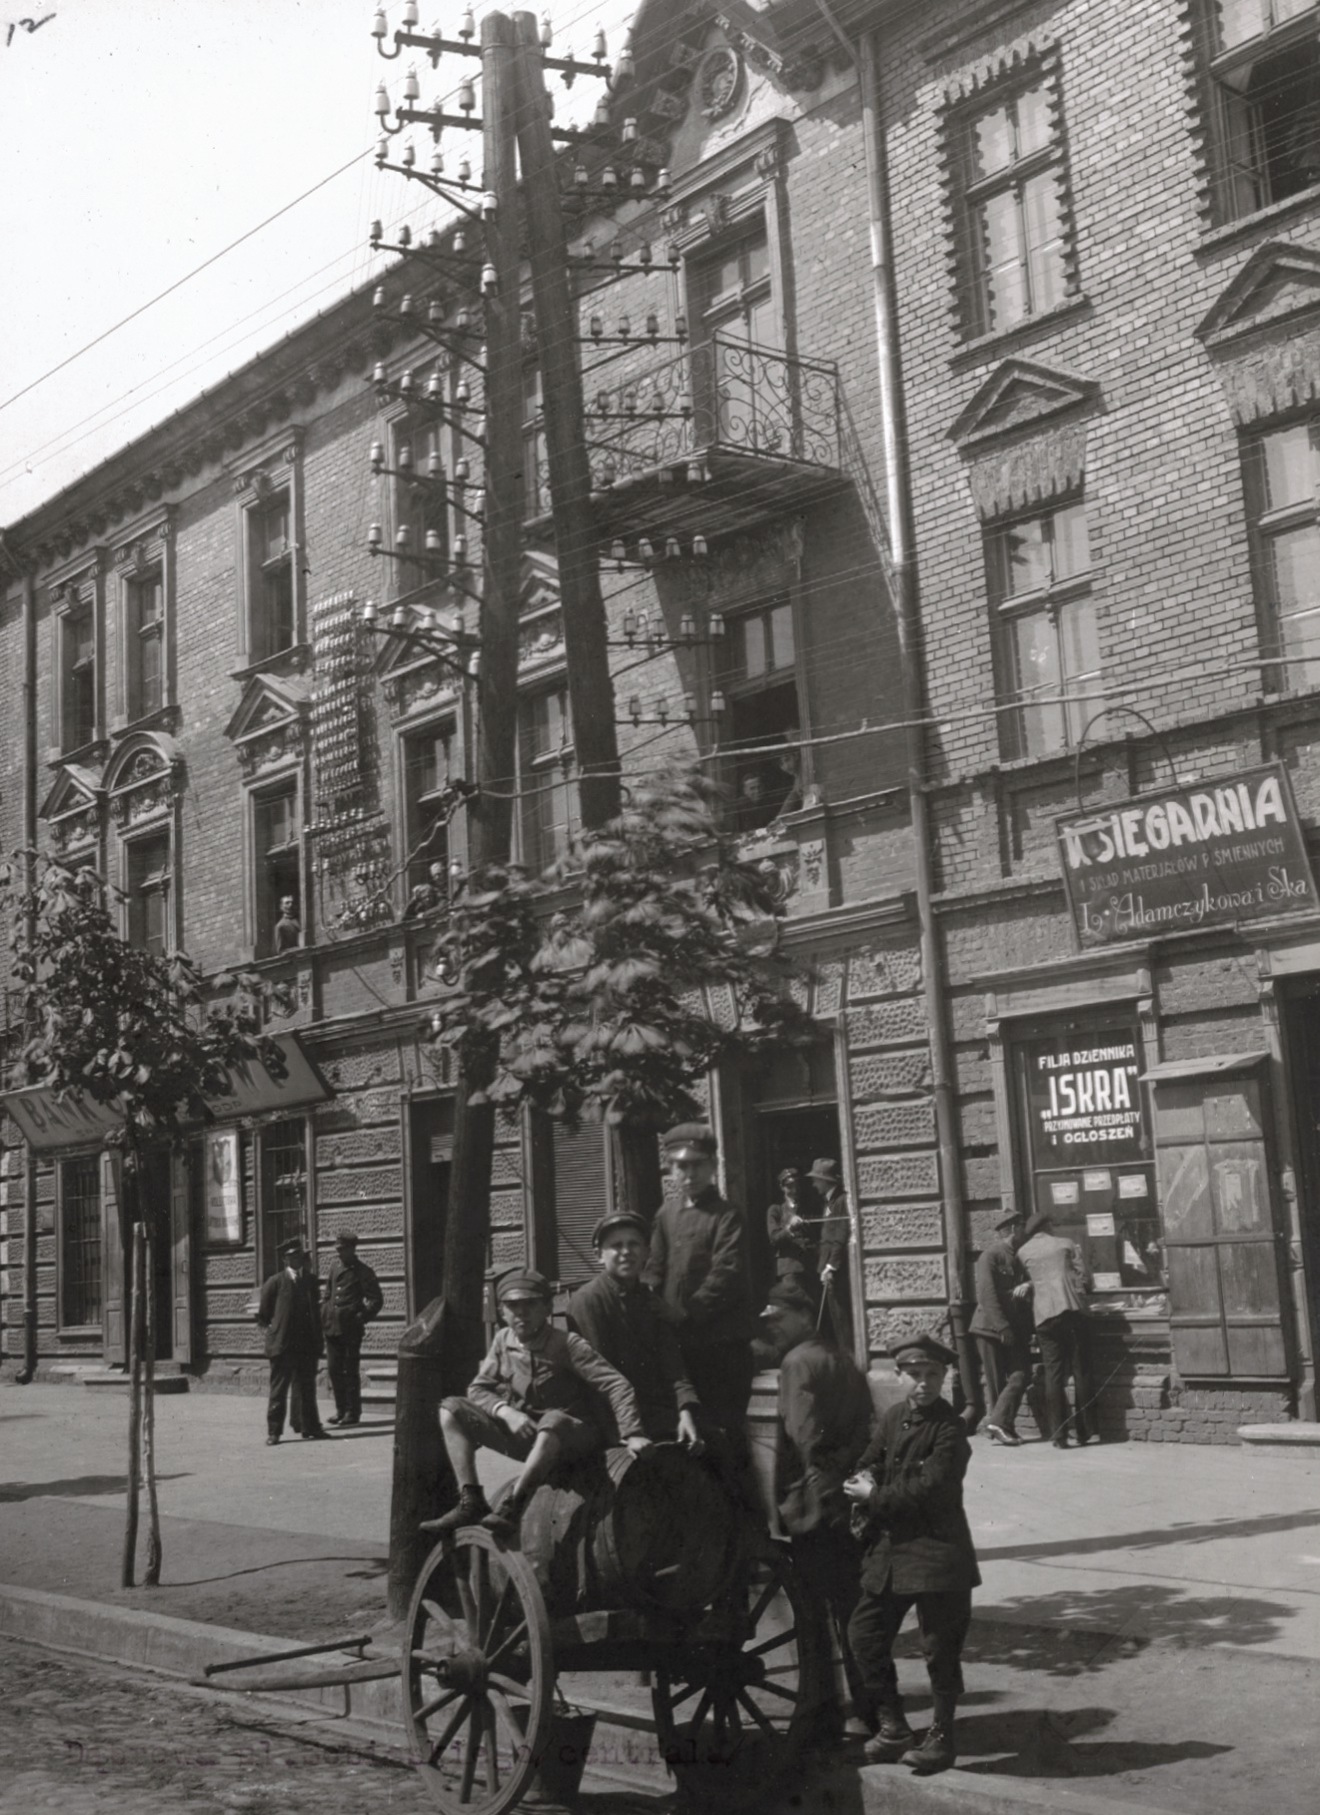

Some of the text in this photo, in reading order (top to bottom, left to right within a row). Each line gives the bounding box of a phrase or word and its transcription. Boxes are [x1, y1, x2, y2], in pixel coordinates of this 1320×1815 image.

[1202, 837, 1285, 869] PŚMIENNYCH
[1038, 1052, 1071, 1070] FILJA
[1063, 1125, 1134, 1143] OGŁOSZEŃ
